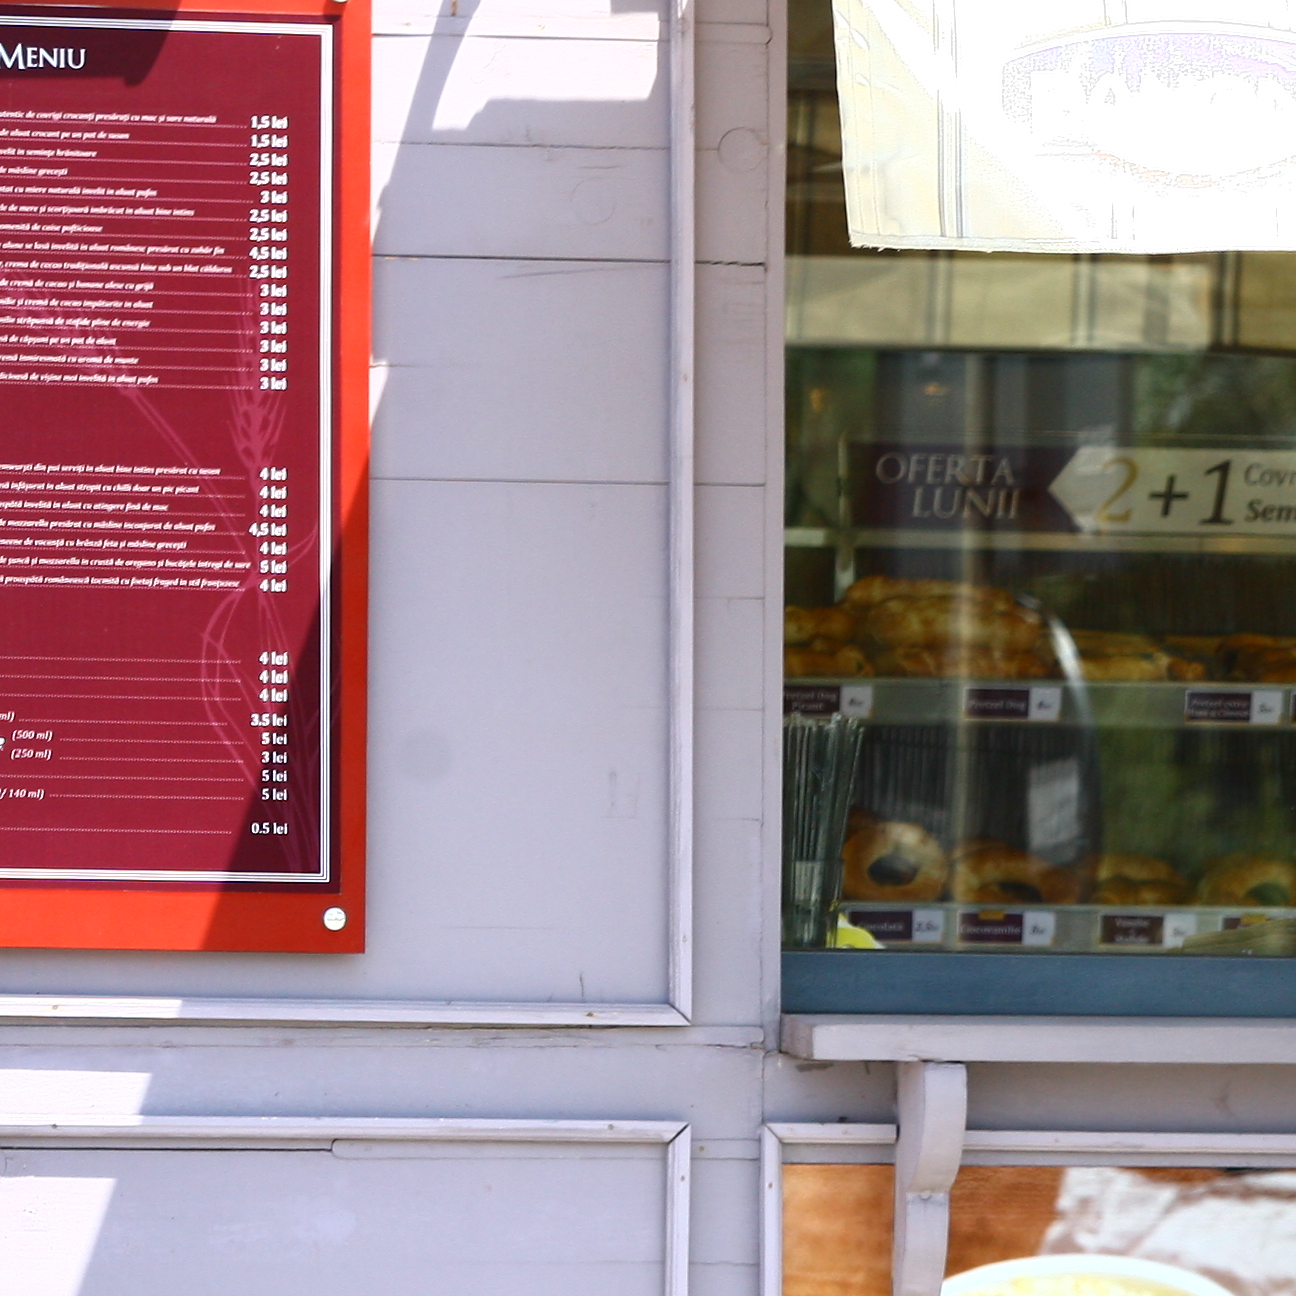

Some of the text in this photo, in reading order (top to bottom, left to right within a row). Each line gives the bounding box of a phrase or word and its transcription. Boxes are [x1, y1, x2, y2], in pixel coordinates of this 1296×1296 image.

[0, 44, 87, 70] MENIU
[251, 116, 288, 129] 1,5 lei
[251, 135, 288, 147] 1,5 lei
[249, 153, 288, 166] 2,5 lei
[249, 172, 288, 185] 2,5 lei
[260, 191, 288, 203] 3 lei
[249, 209, 288, 222] 2,5 lei
[249, 228, 288, 241] 2,5 lei
[248, 247, 288, 260] 4,5 lei
[249, 265, 288, 279] 2,5 lei
[259, 284, 287, 297] 3 lei
[259, 303, 287, 315] 3 lei
[259, 321, 287, 334] 3 lei
[259, 340, 287, 352] 3 lei
[259, 359, 287, 371] 3 lei
[259, 377, 287, 390] 3 lei
[259, 467, 287, 480] 4 lei
[875, 452, 1016, 486] OFERTA
[259, 486, 287, 499] 4 lei
[912, 486, 1020, 519] LUNII
[259, 505, 287, 517] 4 lei
[248, 523, 287, 537] 4,5 lei
[259, 542, 287, 555] 4 lei
[260, 560, 287, 573] 5 lei
[259, 579, 287, 592] 4 lei
[259, 652, 288, 665] 4 lei
[259, 670, 289, 683] 4 lei
[259, 688, 288, 702] 4 lei
[250, 714, 287, 726] 3.5 lei
[12, 730, 53, 742] (500 ml)
[261, 733, 288, 744] 5 lei
[11, 749, 52, 761] (250 ml)
[261, 751, 288, 763] 3 lei
[261, 770, 288, 781] 5 lei
[9, 789, 45, 800] 140 ml)
[261, 789, 288, 800] 5 lei
[251, 823, 288, 834] 0.5 lei
